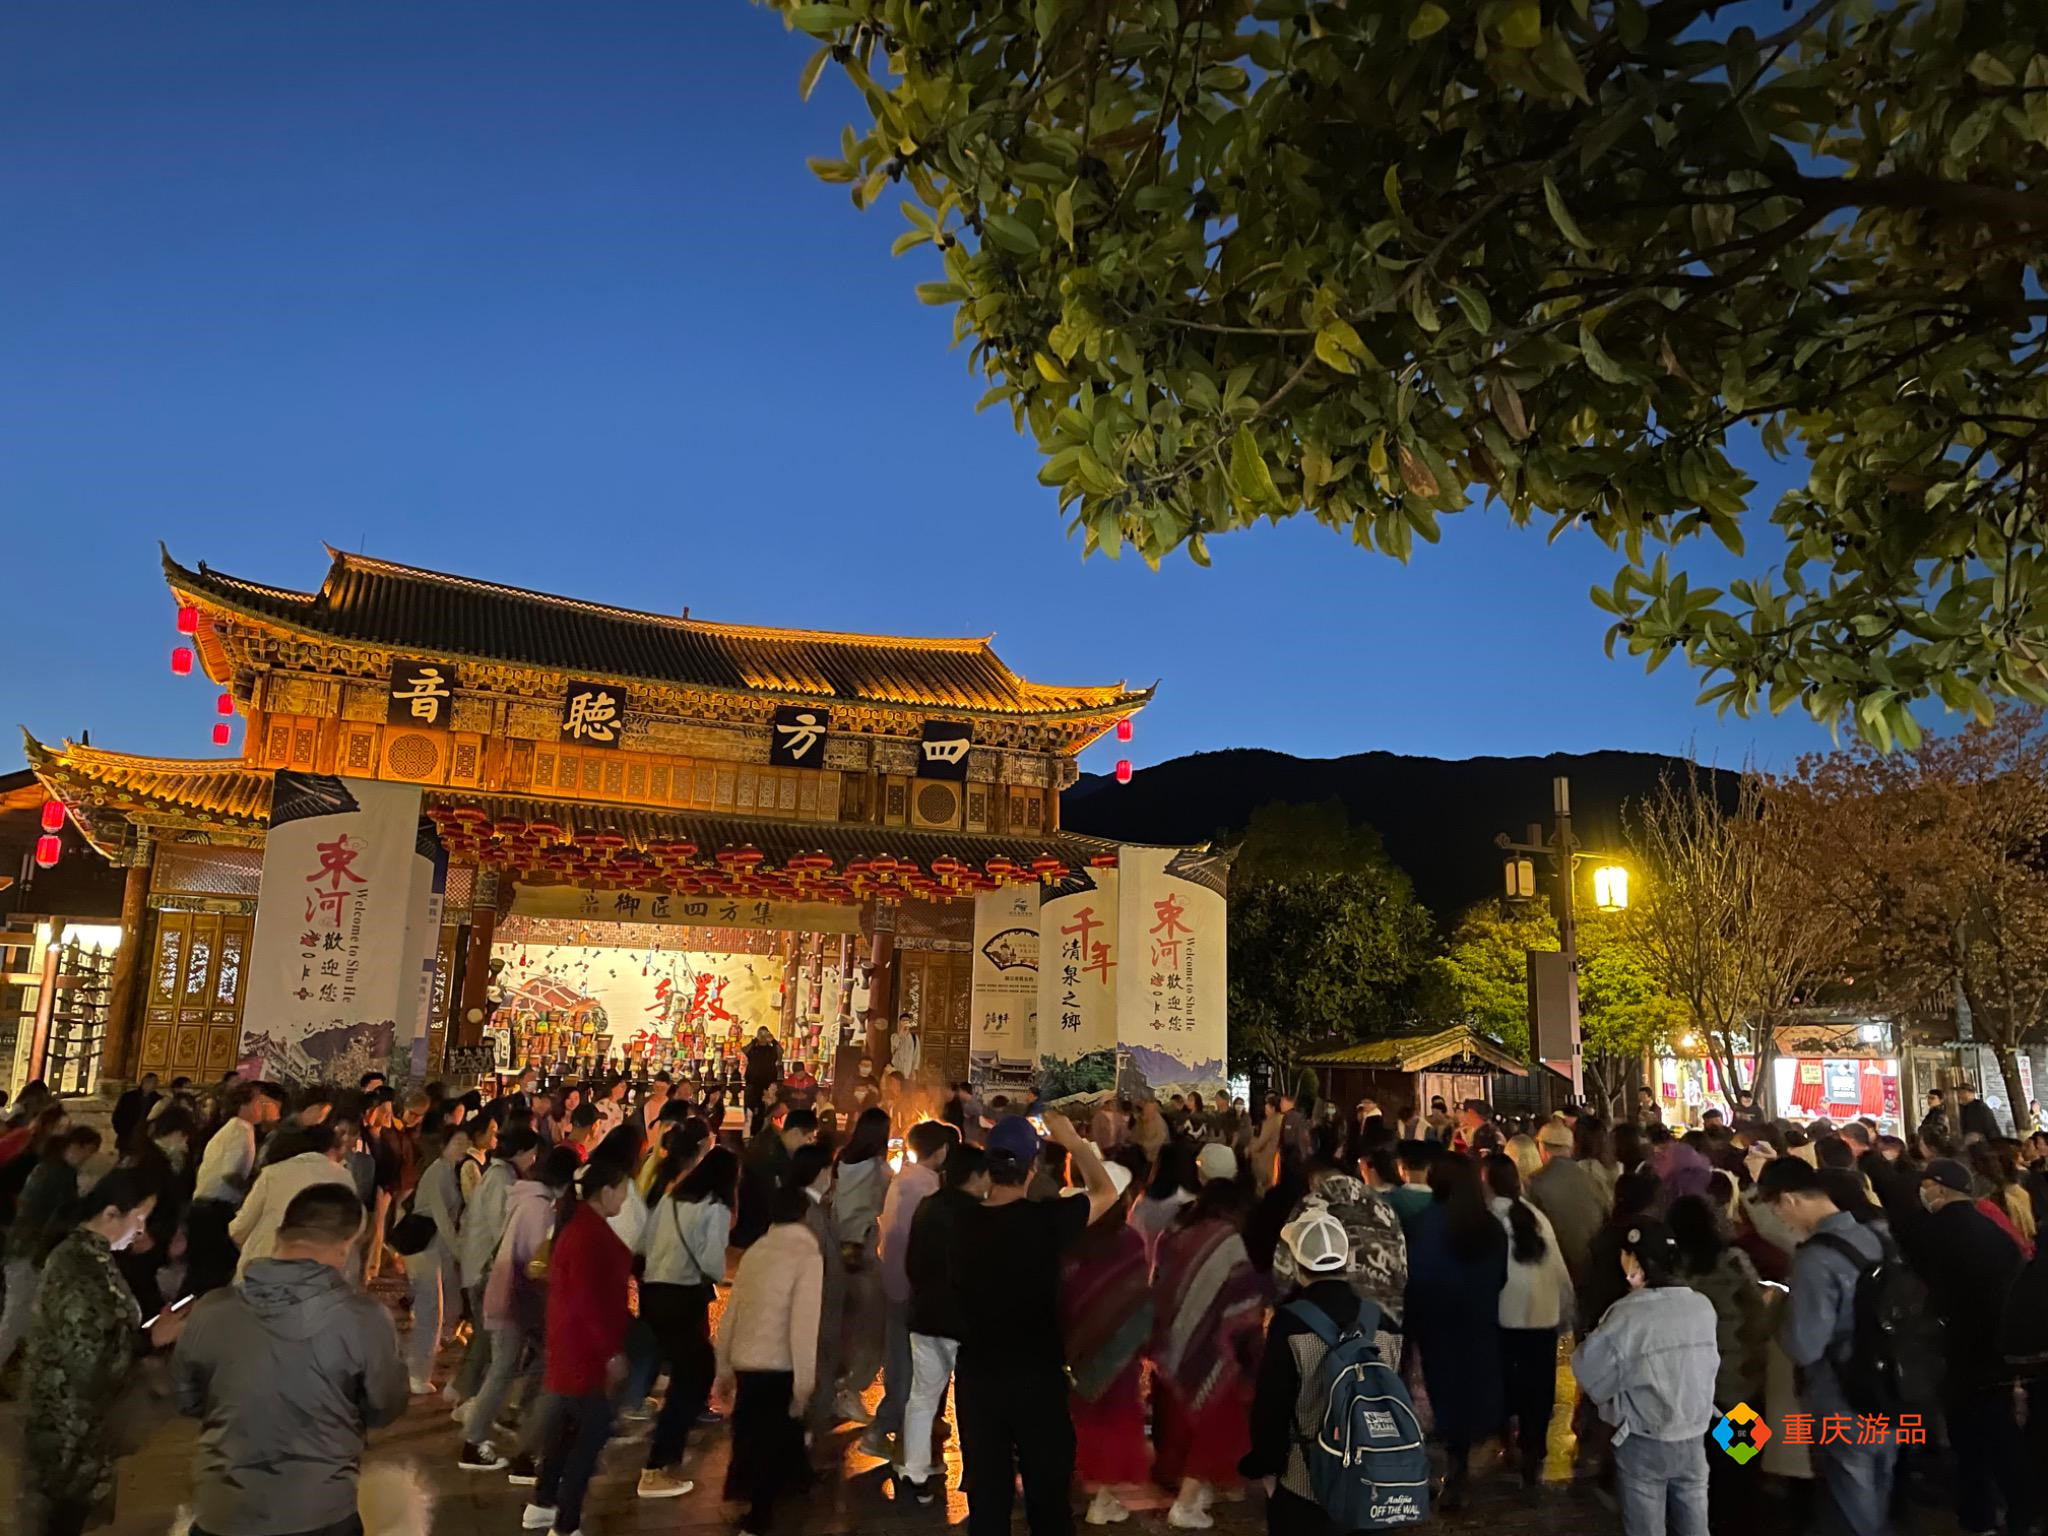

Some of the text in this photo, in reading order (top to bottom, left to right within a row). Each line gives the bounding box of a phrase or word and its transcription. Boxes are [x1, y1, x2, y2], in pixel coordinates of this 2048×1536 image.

[392, 668, 450, 723] 音
[776, 713, 826, 760] 方
[922, 738, 970, 765] 四
[350, 888, 369, 943] Welcome
[1061, 907, 1118, 985] 千年
[1185, 937, 1196, 981] Welcome
[345, 959, 360, 983] Shu
[342, 986, 356, 1003] He
[1185, 996, 1196, 1015] Shu
[1185, 1018, 1196, 1032] He
[1370, 1505, 1387, 1518] OFF
[1387, 1504, 1402, 1515] THE
